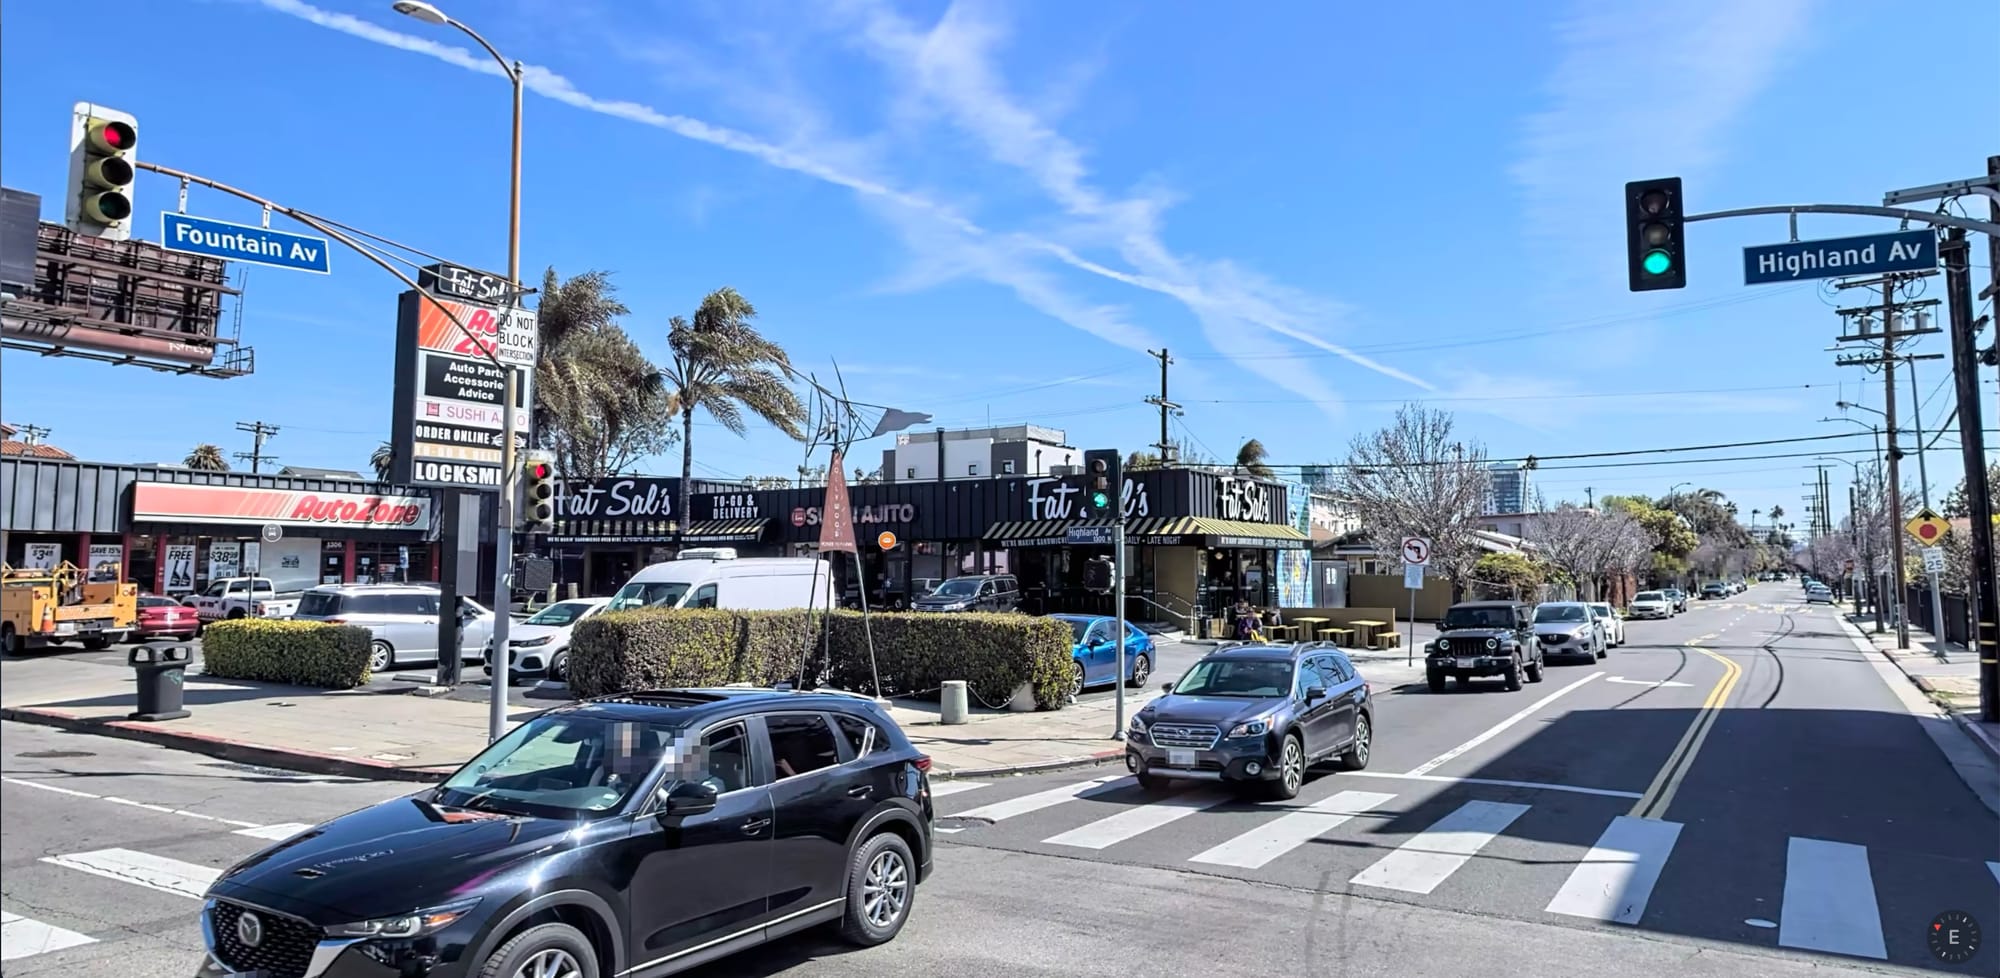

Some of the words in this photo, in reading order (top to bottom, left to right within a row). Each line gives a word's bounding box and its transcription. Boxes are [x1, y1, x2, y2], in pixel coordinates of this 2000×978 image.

[176, 223, 282, 257] Fountain
[290, 242, 317, 262] Av
[1759, 243, 1876, 277] Highland
[1888, 241, 1921, 262] Av
[450, 268, 477, 296] Fat
[467, 308, 497, 334] Au
[500, 313, 512, 328] DO
[517, 317, 534, 331] NOT
[500, 332, 534, 349] BLOCK
[499, 348, 534, 361] INTERSECTION
[449, 362, 475, 374] Auto
[444, 373, 504, 390] Accessorie
[458, 387, 494, 400] Advice
[447, 406, 486, 422] SUSHI
[416, 425, 451, 440] ORDER
[454, 429, 490, 444] ONLINE
[415, 462, 501, 485] LOCKSMI
[606, 480, 671, 516] Sal's
[714, 495, 743, 507] TO-GO
[747, 494, 754, 506] &
[1027, 477, 1079, 520] Fat
[1220, 476, 1243, 519] Fat
[1241, 481, 1269, 522] Sal's
[291, 495, 420, 524] AutoZone
[713, 506, 758, 519] DELIVERY
[861, 503, 914, 524] AJITO
[1068, 527, 1099, 540] Highland
[1147, 535, 1161, 545] LATE
[1162, 535, 1181, 545] NIGHT
[91, 546, 106, 554] SAVE
[168, 550, 192, 560] FREE
[1927, 560, 1944, 571] 25
